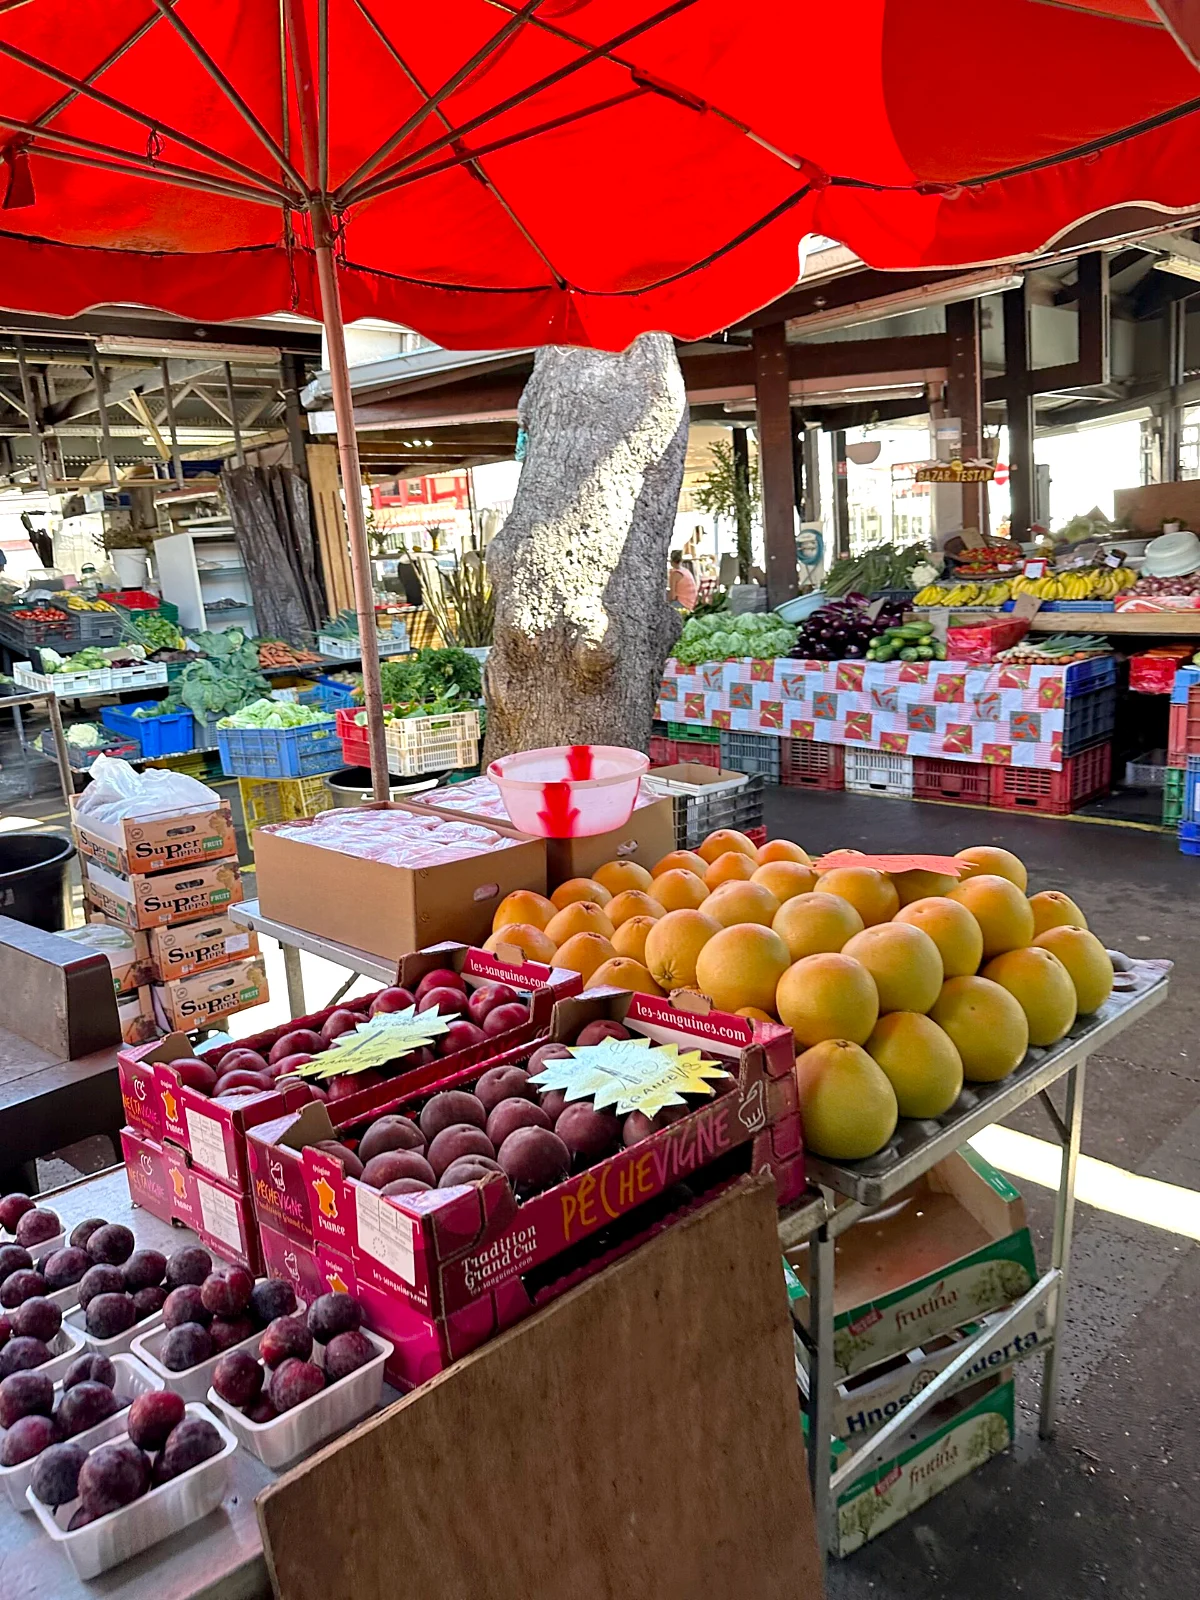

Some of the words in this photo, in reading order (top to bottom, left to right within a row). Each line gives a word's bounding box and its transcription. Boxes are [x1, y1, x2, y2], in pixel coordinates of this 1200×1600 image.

[920, 470, 951, 481] BAZAR
[135, 839, 200, 860] Super
[203, 839, 223, 849] FRUIT
[144, 892, 208, 913] Super
[210, 892, 230, 902] FRUIT
[181, 991, 238, 1017] Super
[240, 989, 259, 1000] FRUIT
[636, 1001, 747, 1042] les-sanguines.com
[318, 1215, 346, 1236] France
[462, 1225, 536, 1273] Tradition
[465, 1250, 511, 1291] Grand
[513, 1239, 537, 1258] Cru
[895, 1287, 958, 1331] frutina
[909, 1443, 959, 1491] frutina
